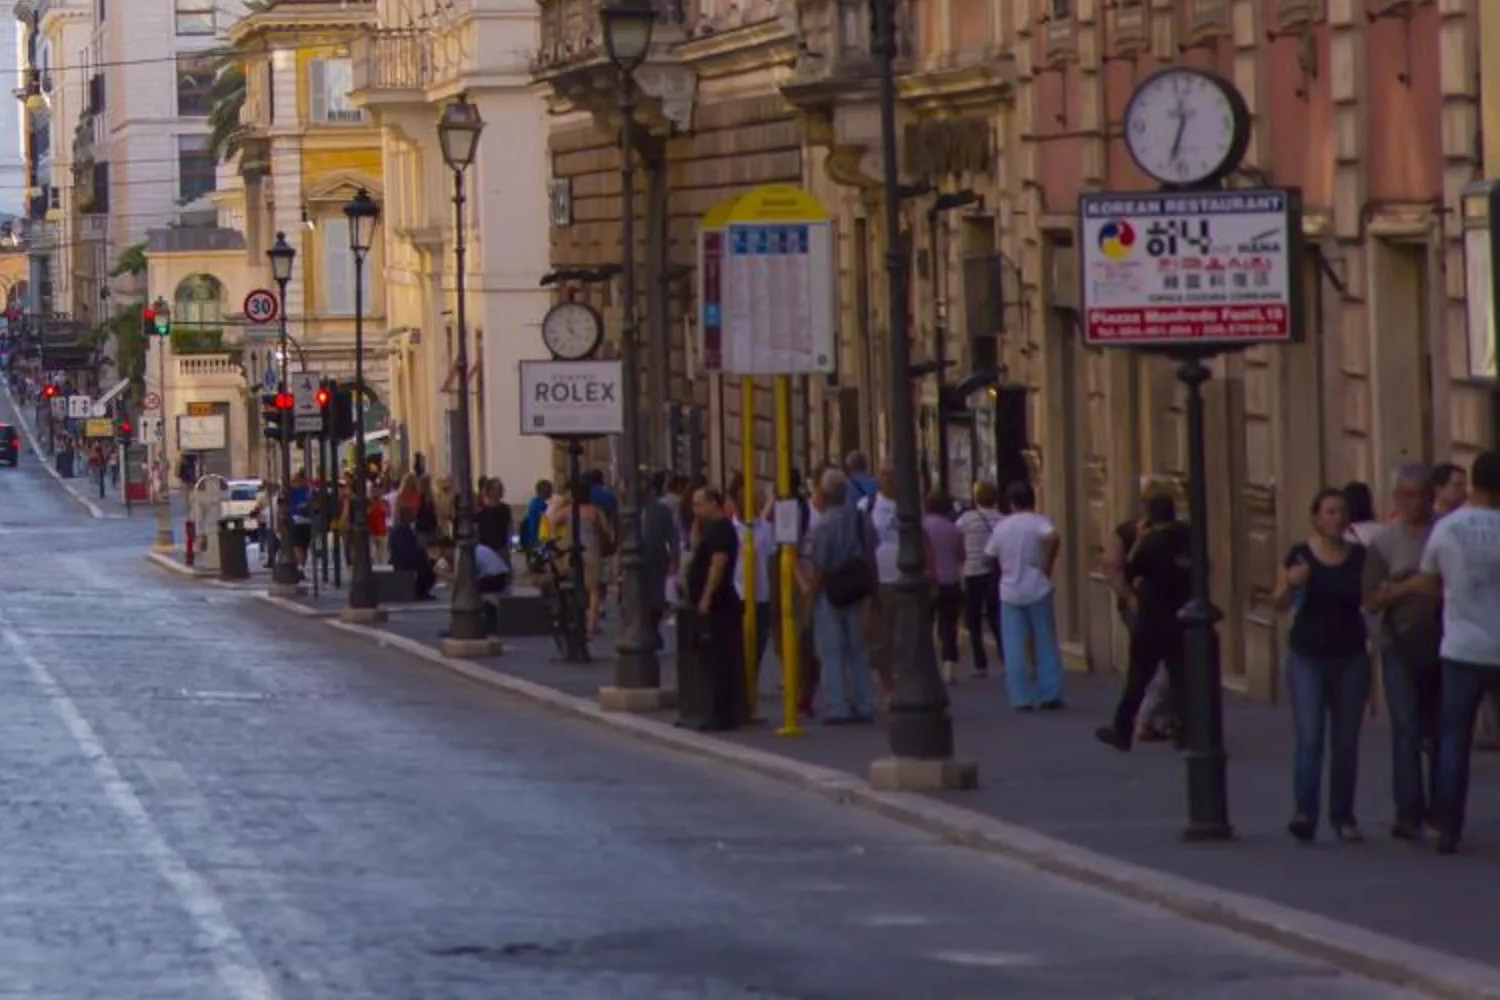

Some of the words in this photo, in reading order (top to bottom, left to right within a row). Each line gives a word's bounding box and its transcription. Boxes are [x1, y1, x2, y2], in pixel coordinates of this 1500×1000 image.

[1087, 200, 1161, 215] KOREAN
[1163, 196, 1281, 213] RESTAURANT
[251, 299, 271, 314] 30
[535, 382, 616, 402] ROLEX
